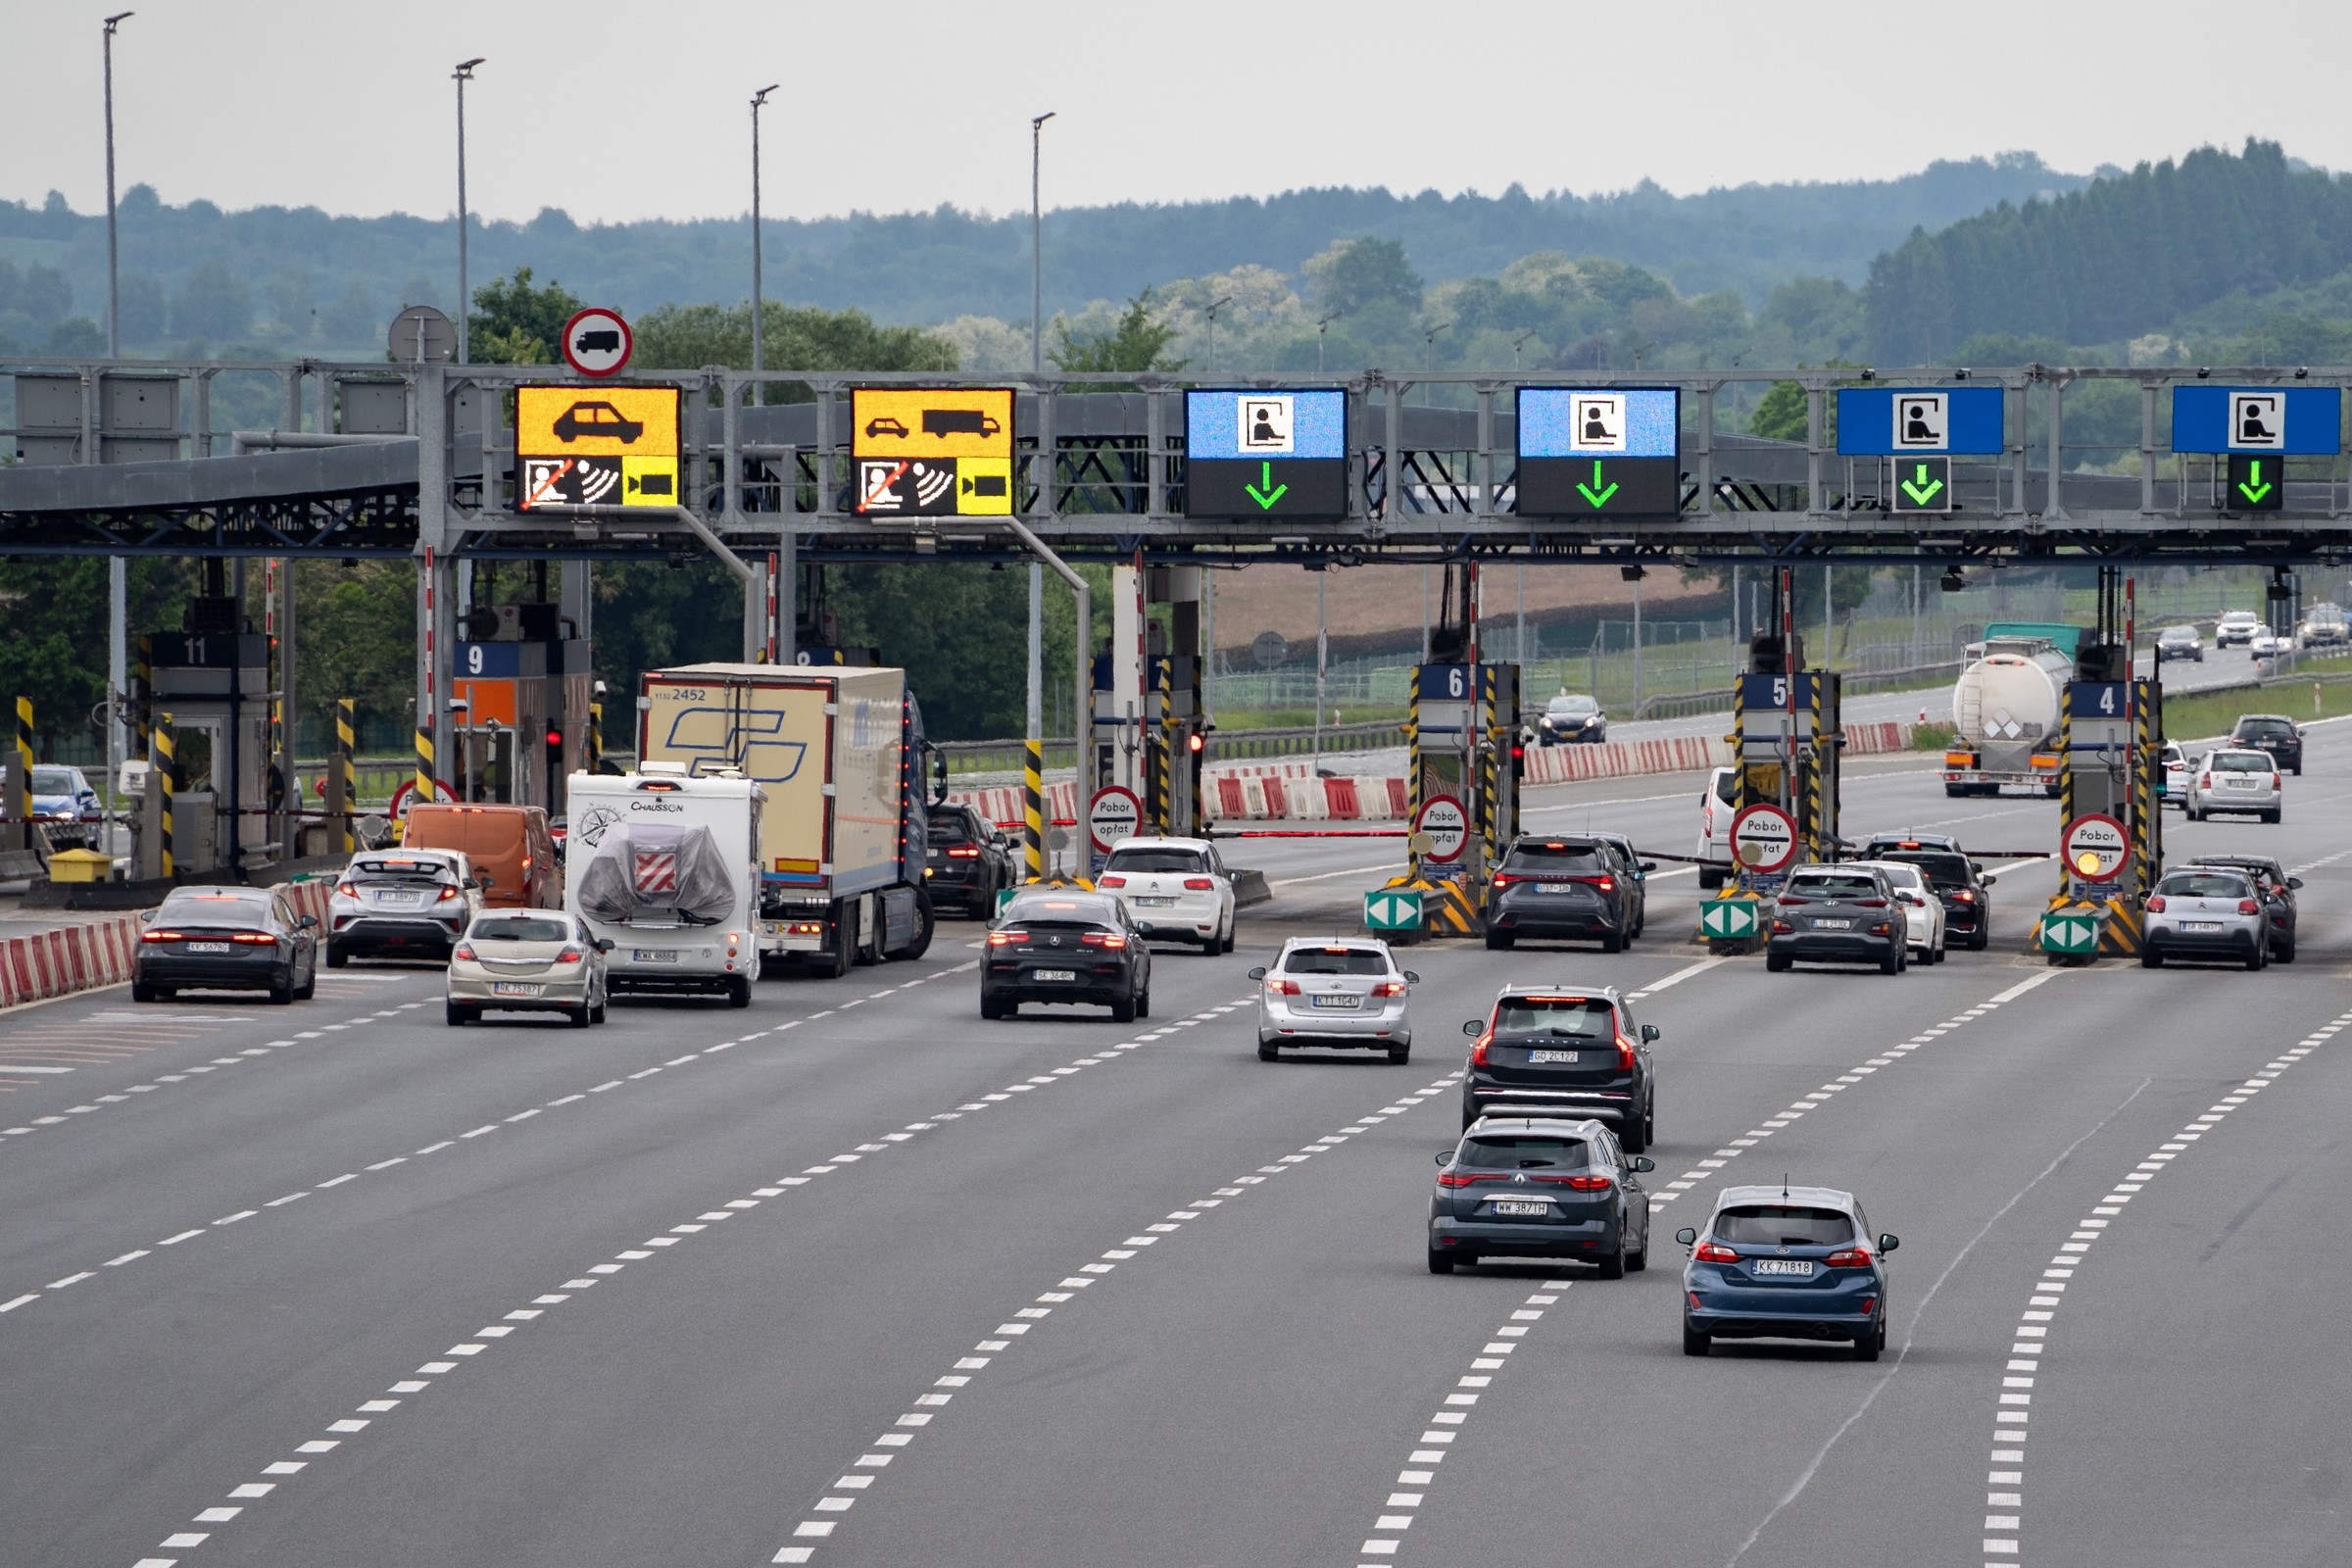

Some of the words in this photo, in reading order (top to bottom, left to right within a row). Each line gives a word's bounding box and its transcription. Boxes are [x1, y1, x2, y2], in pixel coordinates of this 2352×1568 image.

[184, 638, 205, 664] 11
[468, 645, 483, 674] 9
[1448, 668, 1463, 698] 6
[672, 688, 706, 702] 2452
[1773, 677, 1787, 707] 5
[2099, 686, 2115, 714] 4
[1100, 801, 1130, 812] Pobór
[1429, 809, 1457, 822] Pobór
[1100, 824, 1129, 837] opłat
[1747, 819, 1783, 832] Pobór
[1432, 832, 1456, 846] płat
[2080, 828, 2115, 842] Pobór
[1763, 844, 1781, 855] łat
[190, 942, 200, 952] KK
[500, 984, 511, 993] RK
[513, 984, 536, 994] 75387
[1534, 1052, 1546, 1061] GD
[1548, 1052, 1576, 1062] 2C122
[1498, 1202, 1511, 1212] WW
[1515, 1202, 1545, 1214] 387TH
[1759, 1260, 1774, 1271] KK
[1777, 1260, 1810, 1273] 71818
